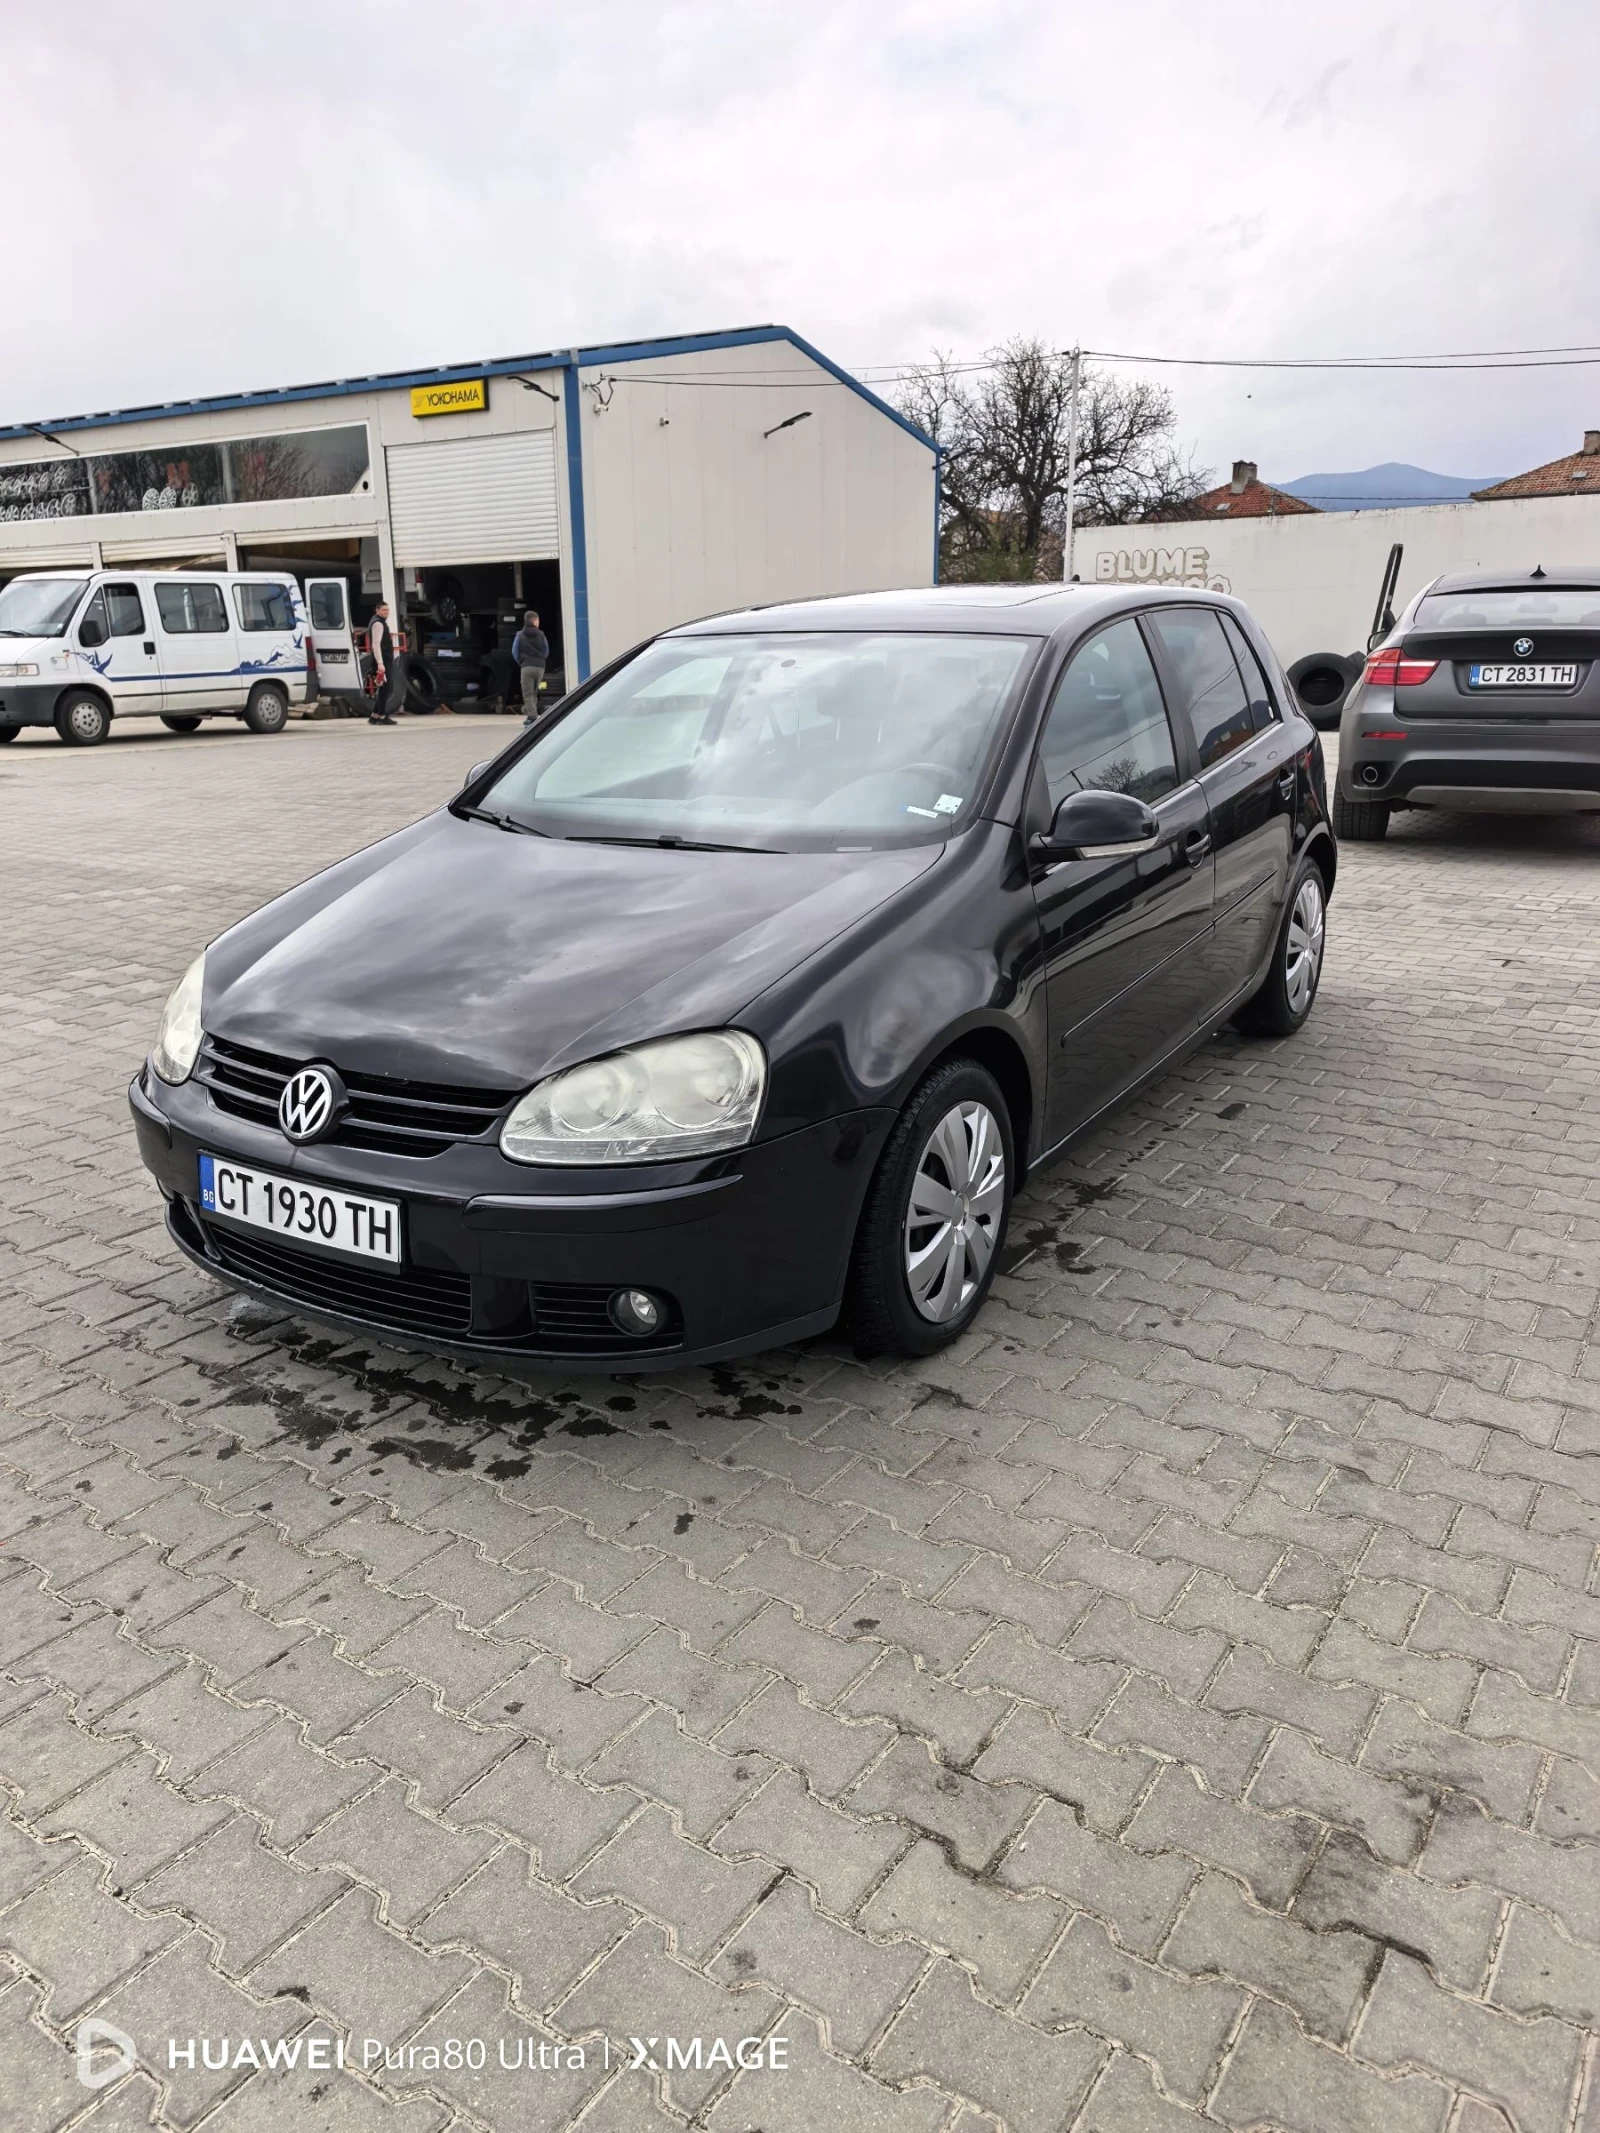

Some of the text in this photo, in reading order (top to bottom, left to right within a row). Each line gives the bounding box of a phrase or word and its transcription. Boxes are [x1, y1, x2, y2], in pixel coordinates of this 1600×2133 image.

[426, 388, 480, 406] YOKOHAMA
[1096, 547, 1209, 581] BLUME
[1482, 666, 1573, 682] CT 2831 TH
[203, 1188, 215, 1203] BG
[218, 1168, 391, 1254] CT 1930 TH
